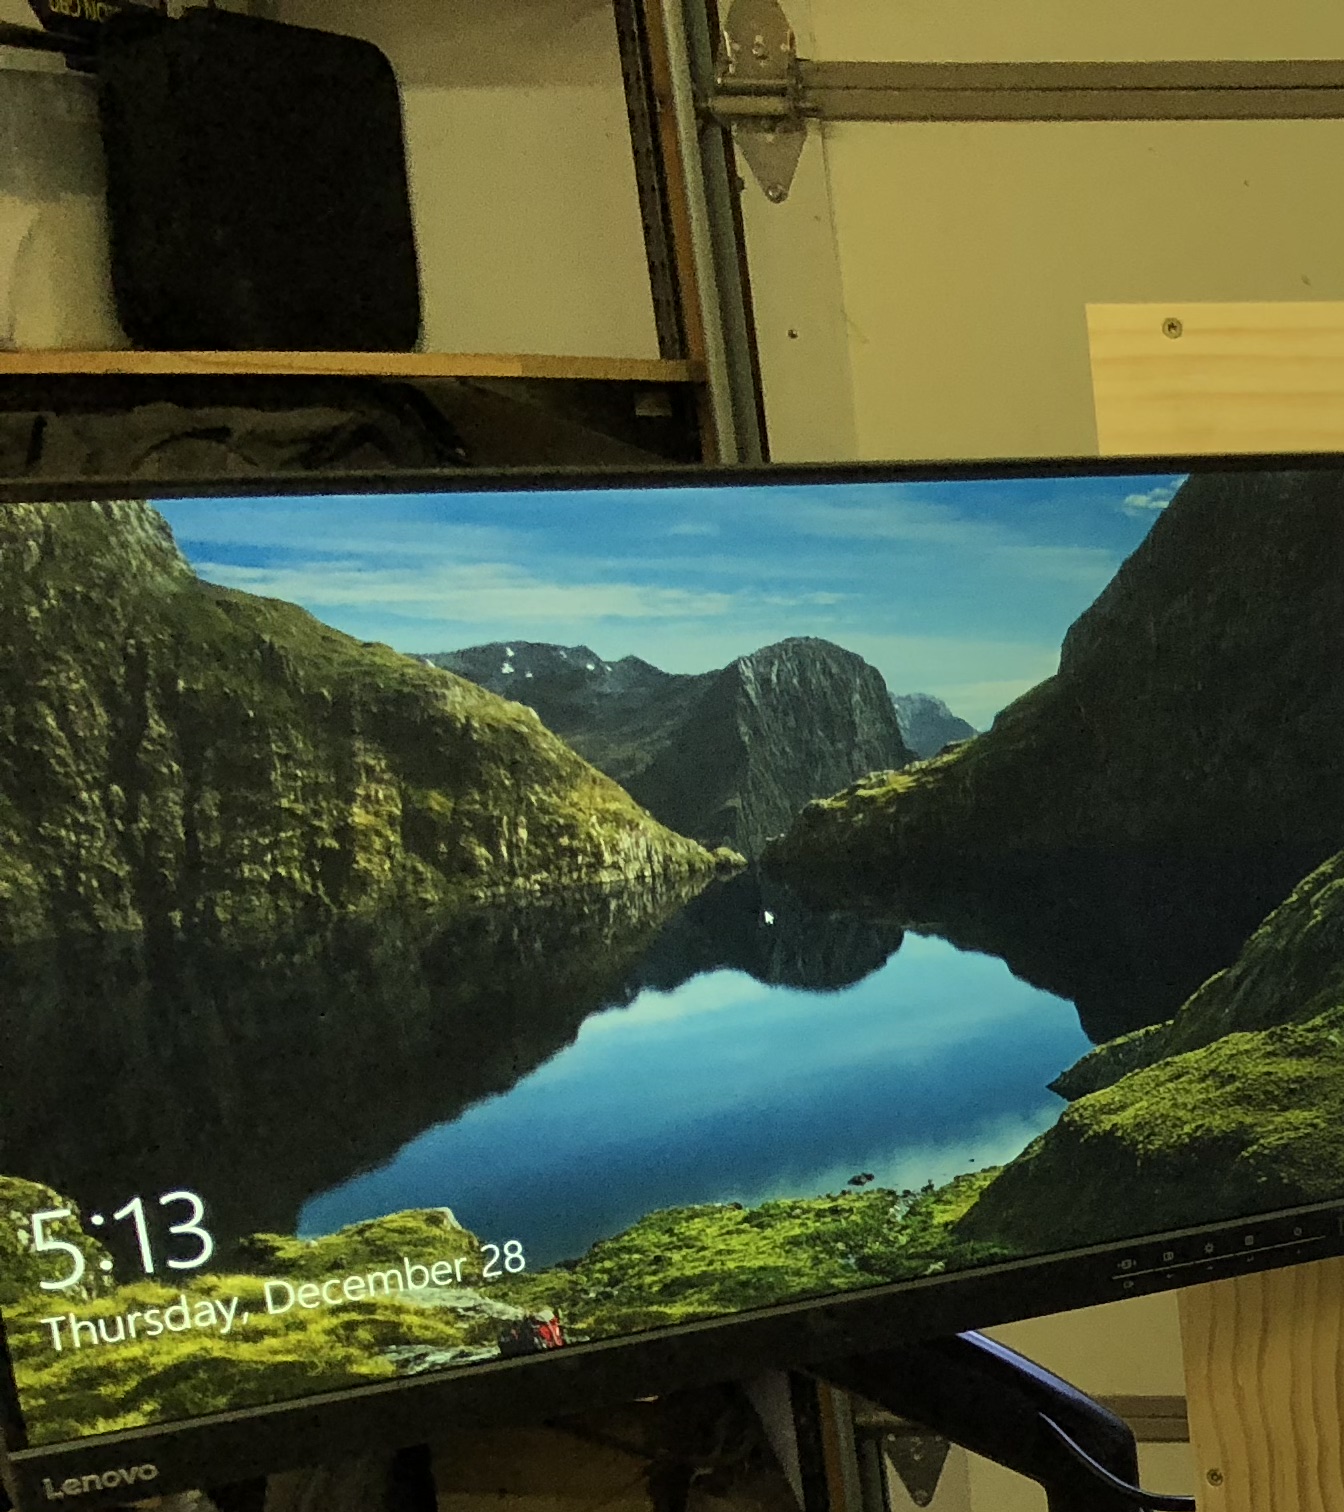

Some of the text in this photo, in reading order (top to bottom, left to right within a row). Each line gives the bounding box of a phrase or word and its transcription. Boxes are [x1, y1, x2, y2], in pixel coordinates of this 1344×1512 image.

[29, 1189, 216, 1293] 5:13
[40, 1239, 527, 1354] Thursday, December 28
[42, 1460, 158, 1501] Lenovo
